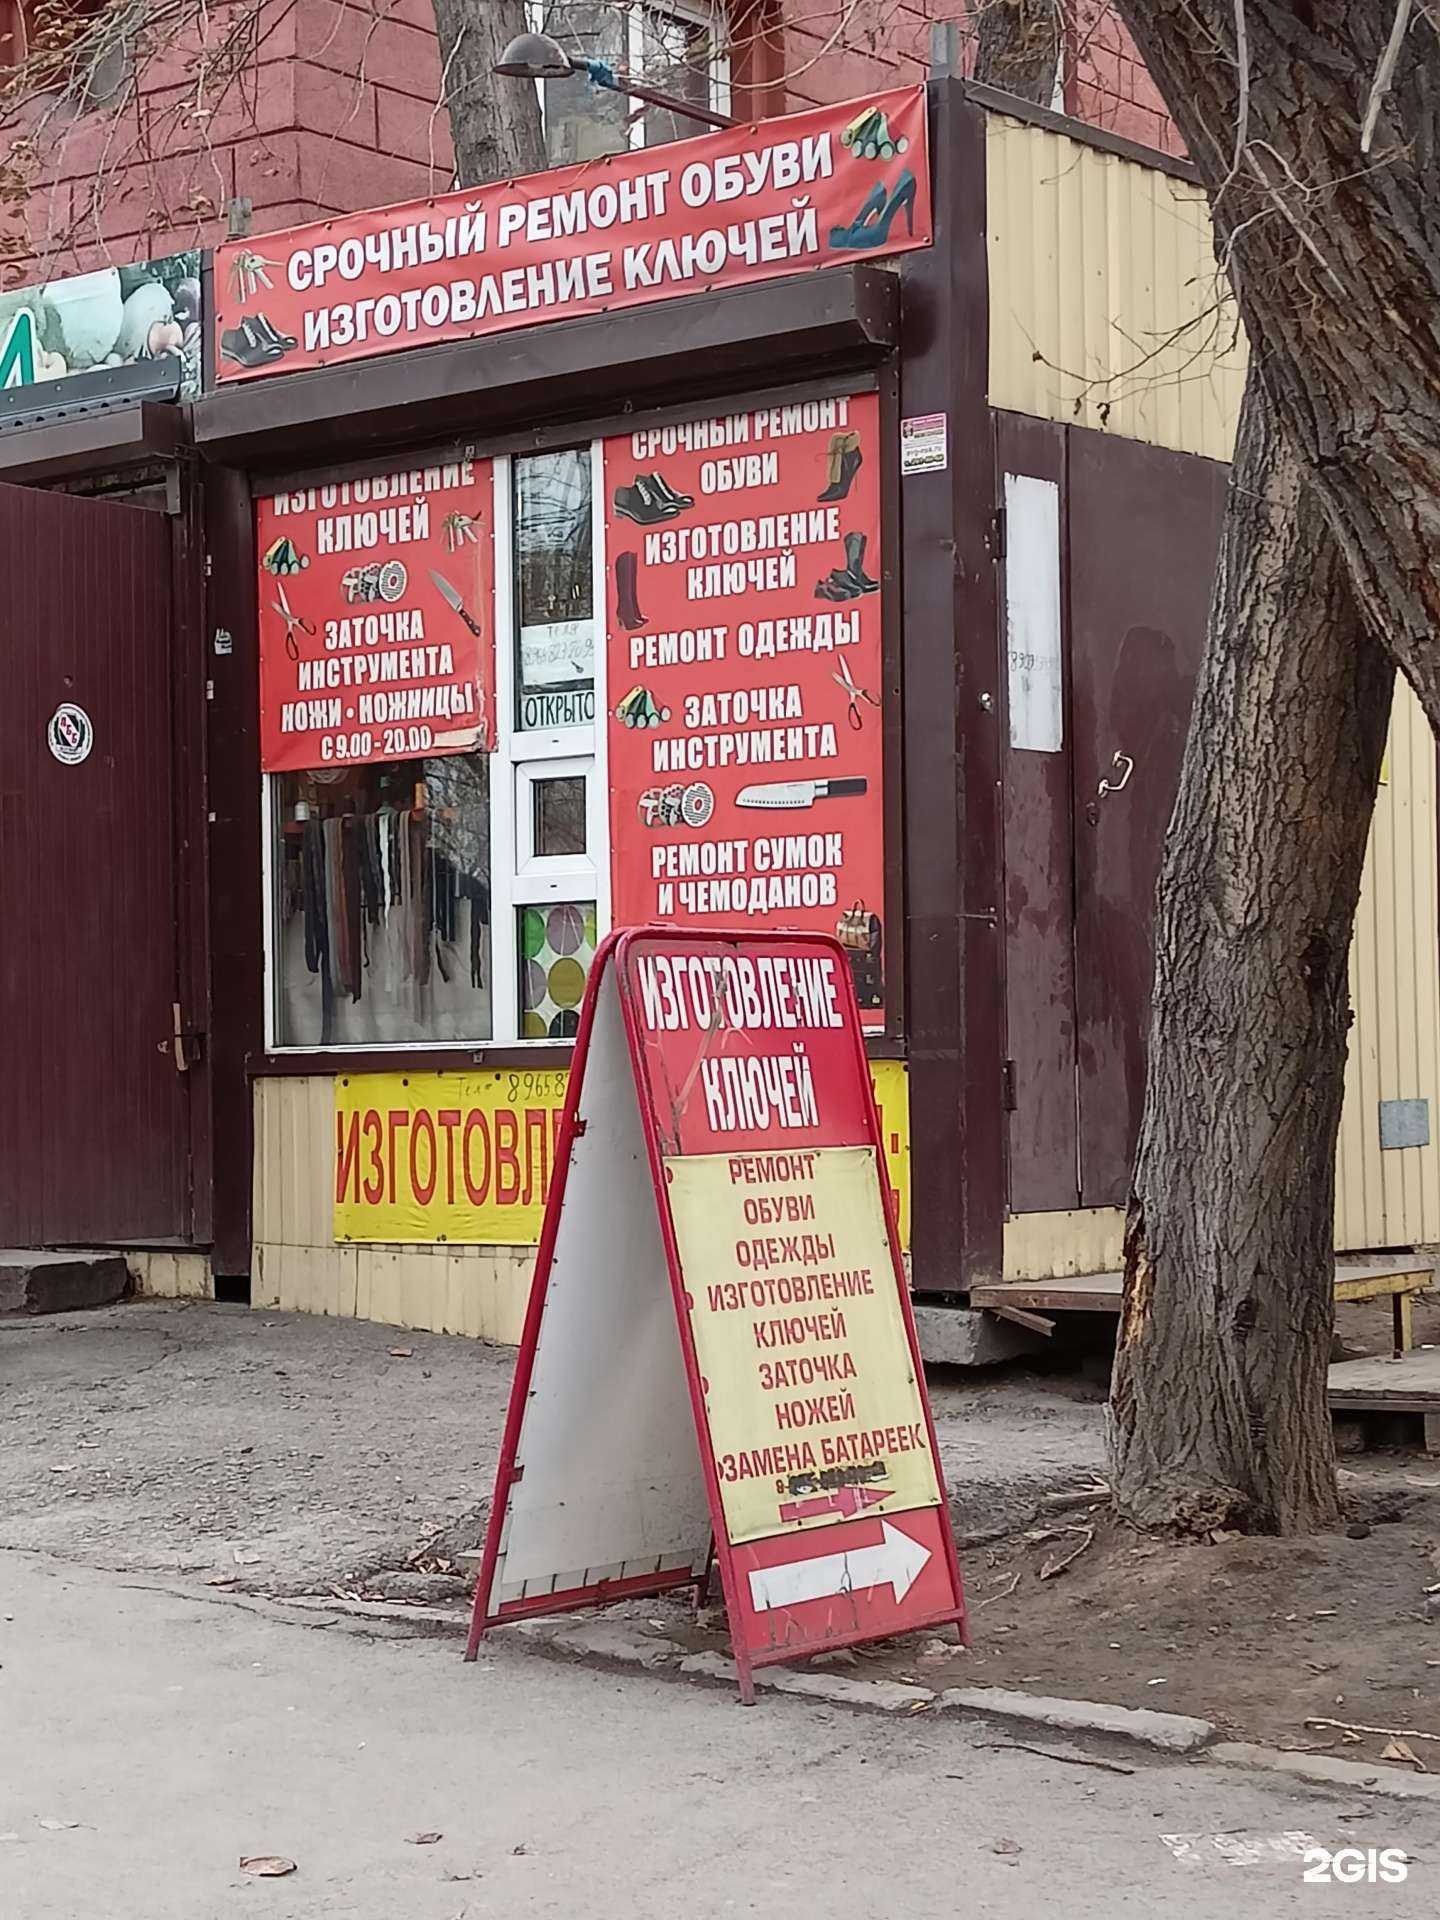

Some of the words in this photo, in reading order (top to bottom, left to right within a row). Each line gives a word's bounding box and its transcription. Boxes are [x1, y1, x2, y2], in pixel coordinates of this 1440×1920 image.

[287, 200, 486, 291] СРОЧНЫЙ
[499, 171, 670, 249] РЕМОНТ
[680, 132, 834, 208] ОБУВИ
[303, 251, 613, 352] ИЗГОТОВЛЕНИЕ
[623, 197, 820, 291] КЛЮЧЕЙ
[754, 396, 850, 441] РЕМОНТ
[700, 451, 778, 494] ОБУВИ
[317, 496, 430, 555] КЛЮЧЕЙ
[645, 507, 840, 566] ИЗГОТОВЛЕНИЕ
[687, 548, 796, 601] КЛЮЧЕЙ
[324, 609, 425, 650] ЗАТОЧКА
[630, 626, 728, 670] РЕМОНТ
[737, 609, 860, 659] ОДЕЖДЫ
[298, 644, 454, 692] ИНСТРУМЕНТА
[281, 698, 342, 733] НОЖИ
[359, 682, 475, 725] НОЖНИЦЫ
[525, 691, 595, 727] ОТКРЫТО
[684, 685, 803, 729] ЗАТОЧКА
[653, 724, 838, 773] ИНСТРУМЕНТА
[652, 840, 749, 878] РЕМОНТ
[754, 833, 843, 872] СУМОК
[657, 883, 674, 915] И
[679, 873, 838, 915] ЧЕМОДАНОВ
[637, 955, 844, 1031] ИЗГОТОВЛЕНИЕ
[700, 1042, 819, 1132] КЛЮЧЕЙ
[728, 1154, 816, 1185] РЕМОНТ
[743, 1194, 816, 1225] ОБУВИ
[736, 1233, 836, 1271] ОДЕЖДЫ
[707, 1269, 875, 1312] ИЗГОТОВЛЕНИЕ
[753, 1307, 847, 1349] КЛЮЧЕЙ
[759, 1352, 857, 1390] ЗАТОЧКА
[775, 1387, 855, 1430] НОЖЕЙ
[721, 1441, 817, 1482] ЗАМЕНА
[820, 1423, 926, 1465] БАТАРЕЕК
